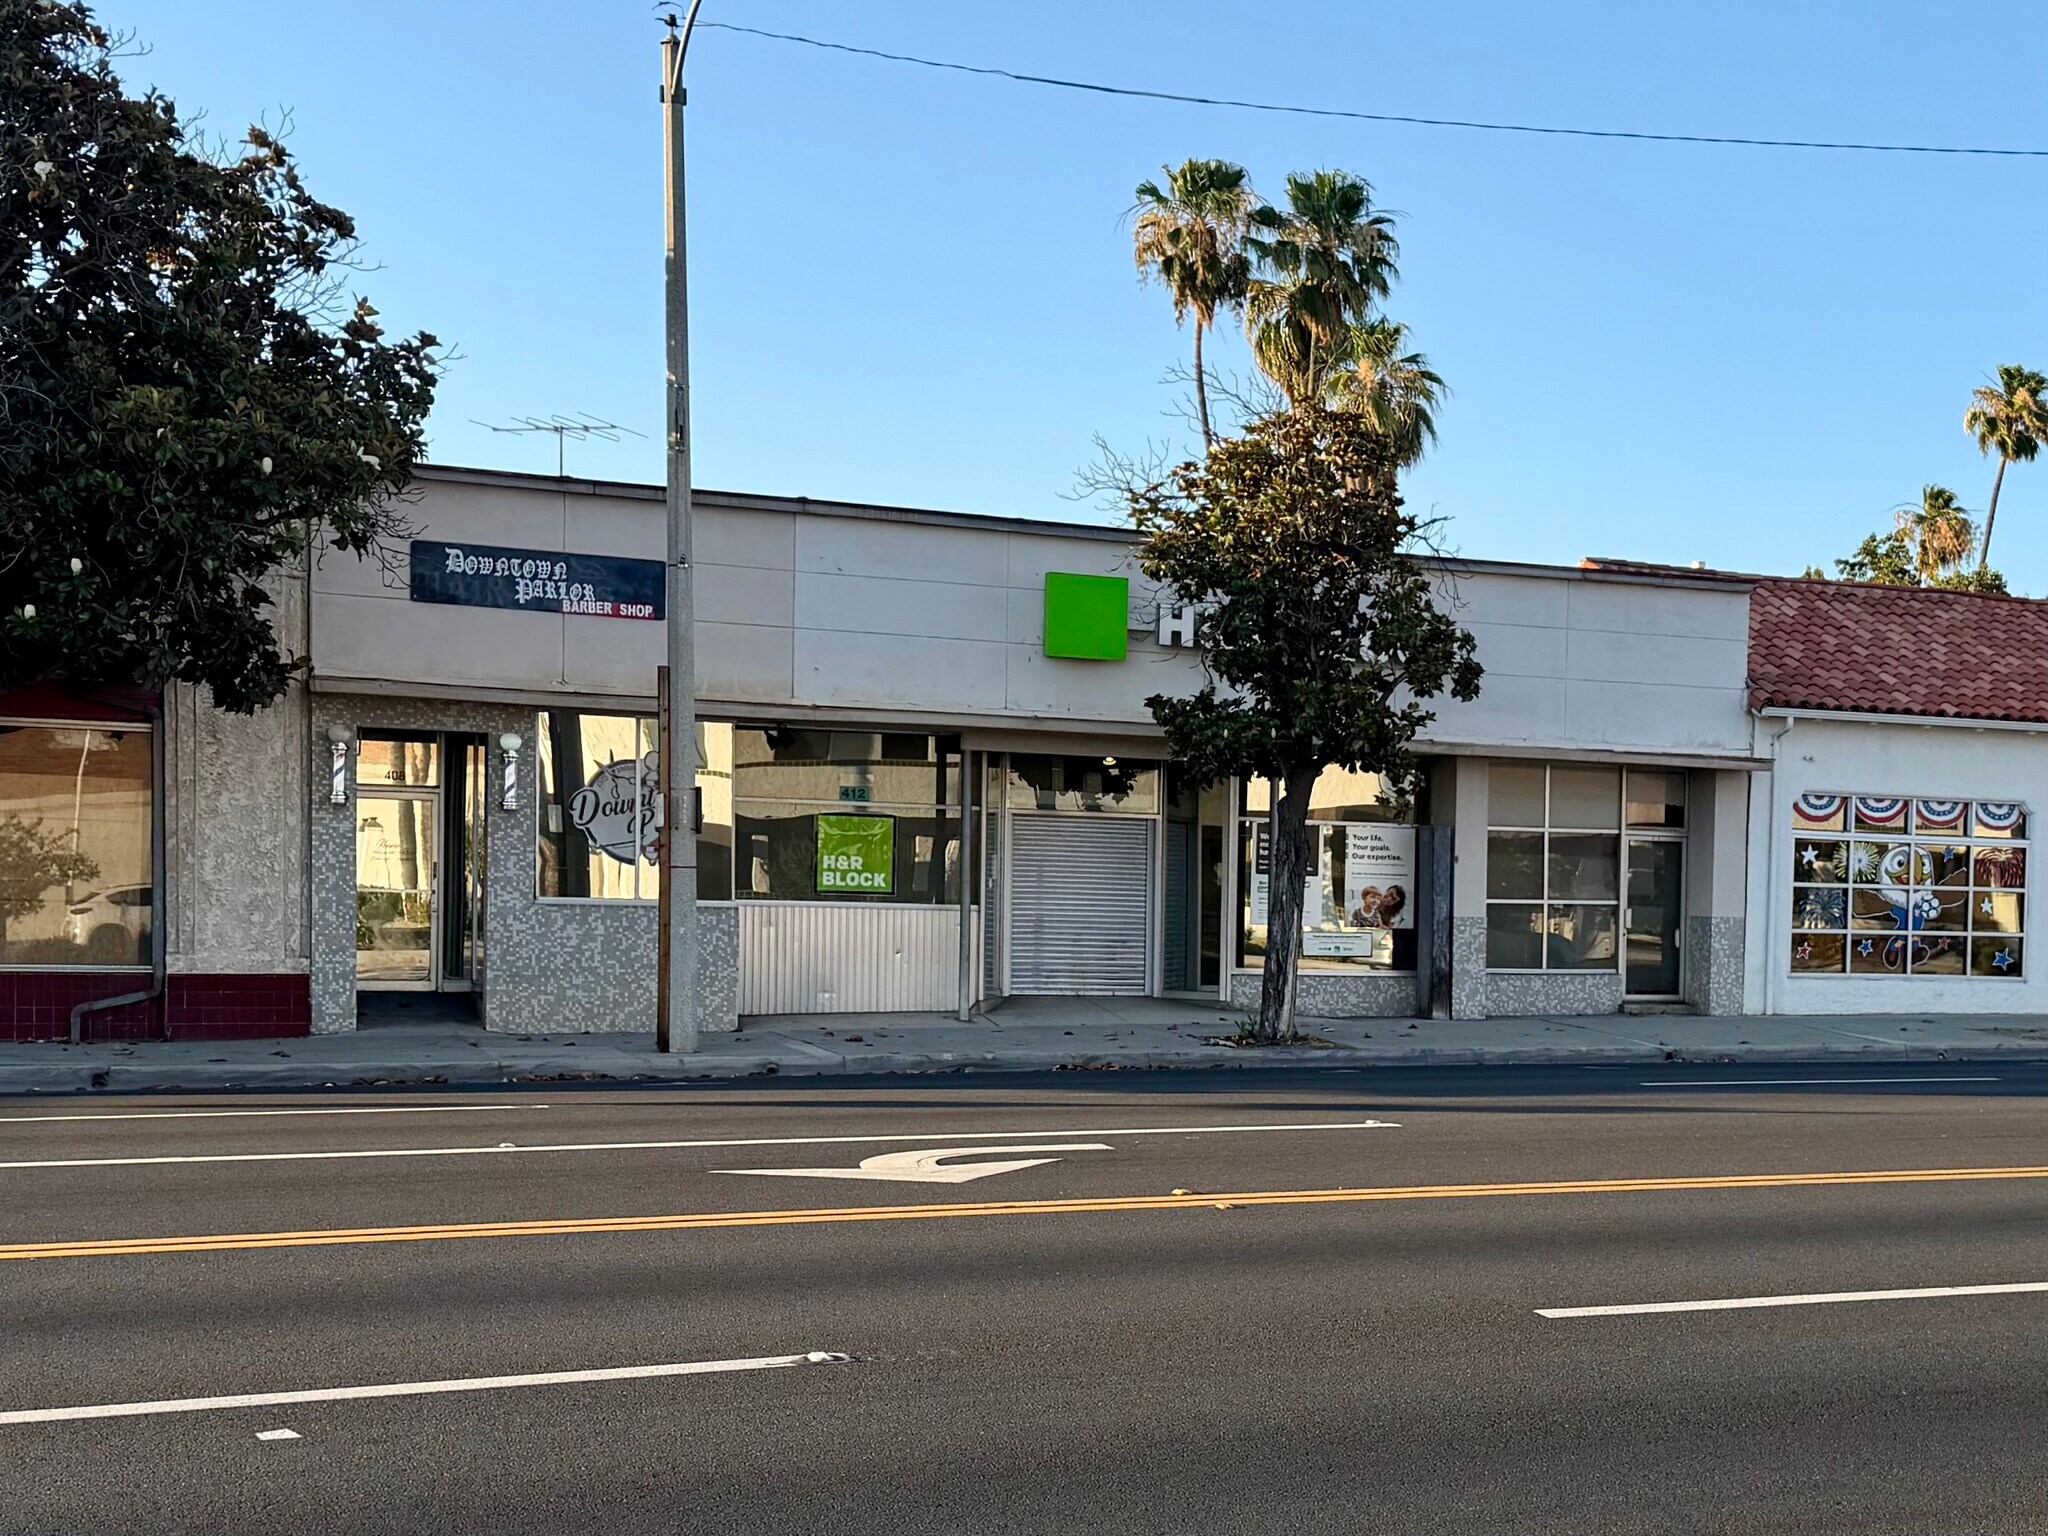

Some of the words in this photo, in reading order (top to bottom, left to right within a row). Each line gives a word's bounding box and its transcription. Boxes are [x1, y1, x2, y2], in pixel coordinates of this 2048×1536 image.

[562, 600, 612, 615] BARBER
[620, 603, 653, 617] SHOP
[384, 770, 406, 781] 408
[841, 788, 866, 799] 412
[822, 855, 863, 870] H&R
[1367, 853, 1403, 861] expertise.
[822, 871, 886, 888] BLOCK
